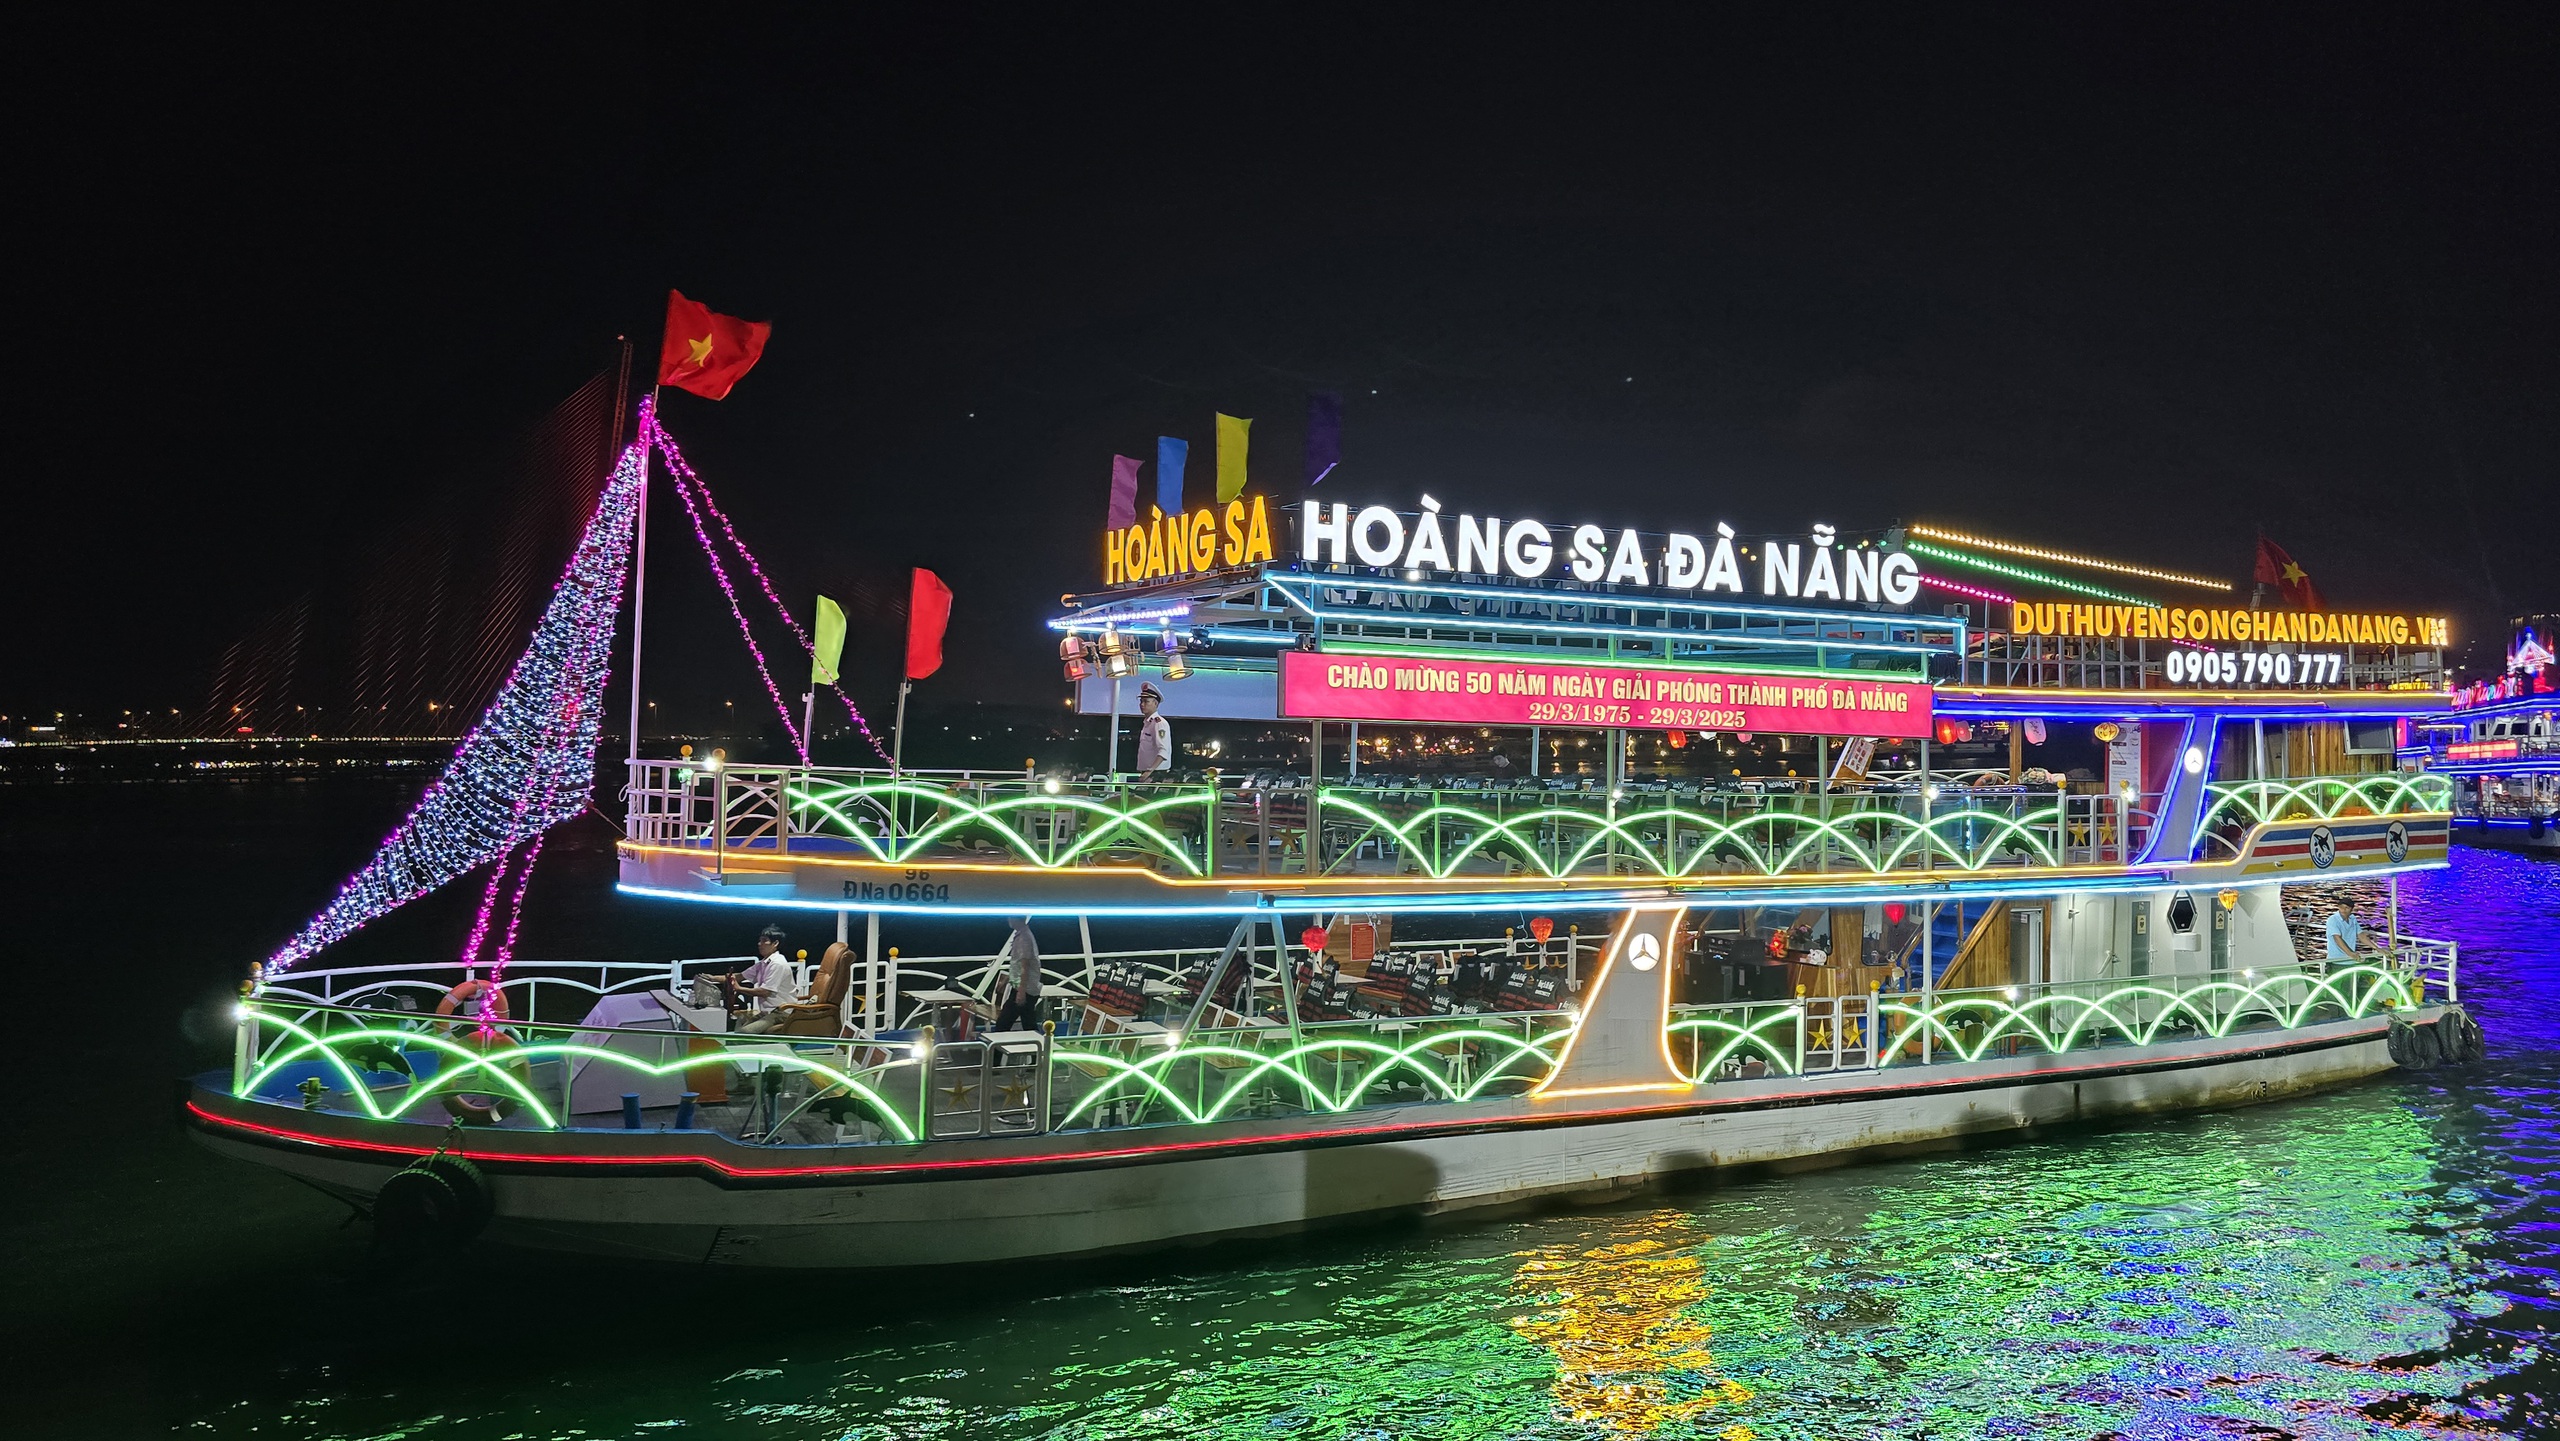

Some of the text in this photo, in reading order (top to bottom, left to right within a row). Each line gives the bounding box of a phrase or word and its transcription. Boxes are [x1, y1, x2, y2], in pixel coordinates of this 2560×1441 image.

[1106, 495, 1273, 585] HOÀNG SA
[1302, 493, 1920, 605] HOÀNG SA ĐÀ NẴNG
[1327, 661, 1908, 713] CHÀO MỪNG 50 NĂM NGÀY GIẢI PHÓNG THÀNH PHỐ ĐÀ NẴNG
[2166, 650, 2342, 684] 0905 790 777
[1528, 702, 1631, 723] 29/3/1975
[1649, 706, 1746, 728] 29/3/2025
